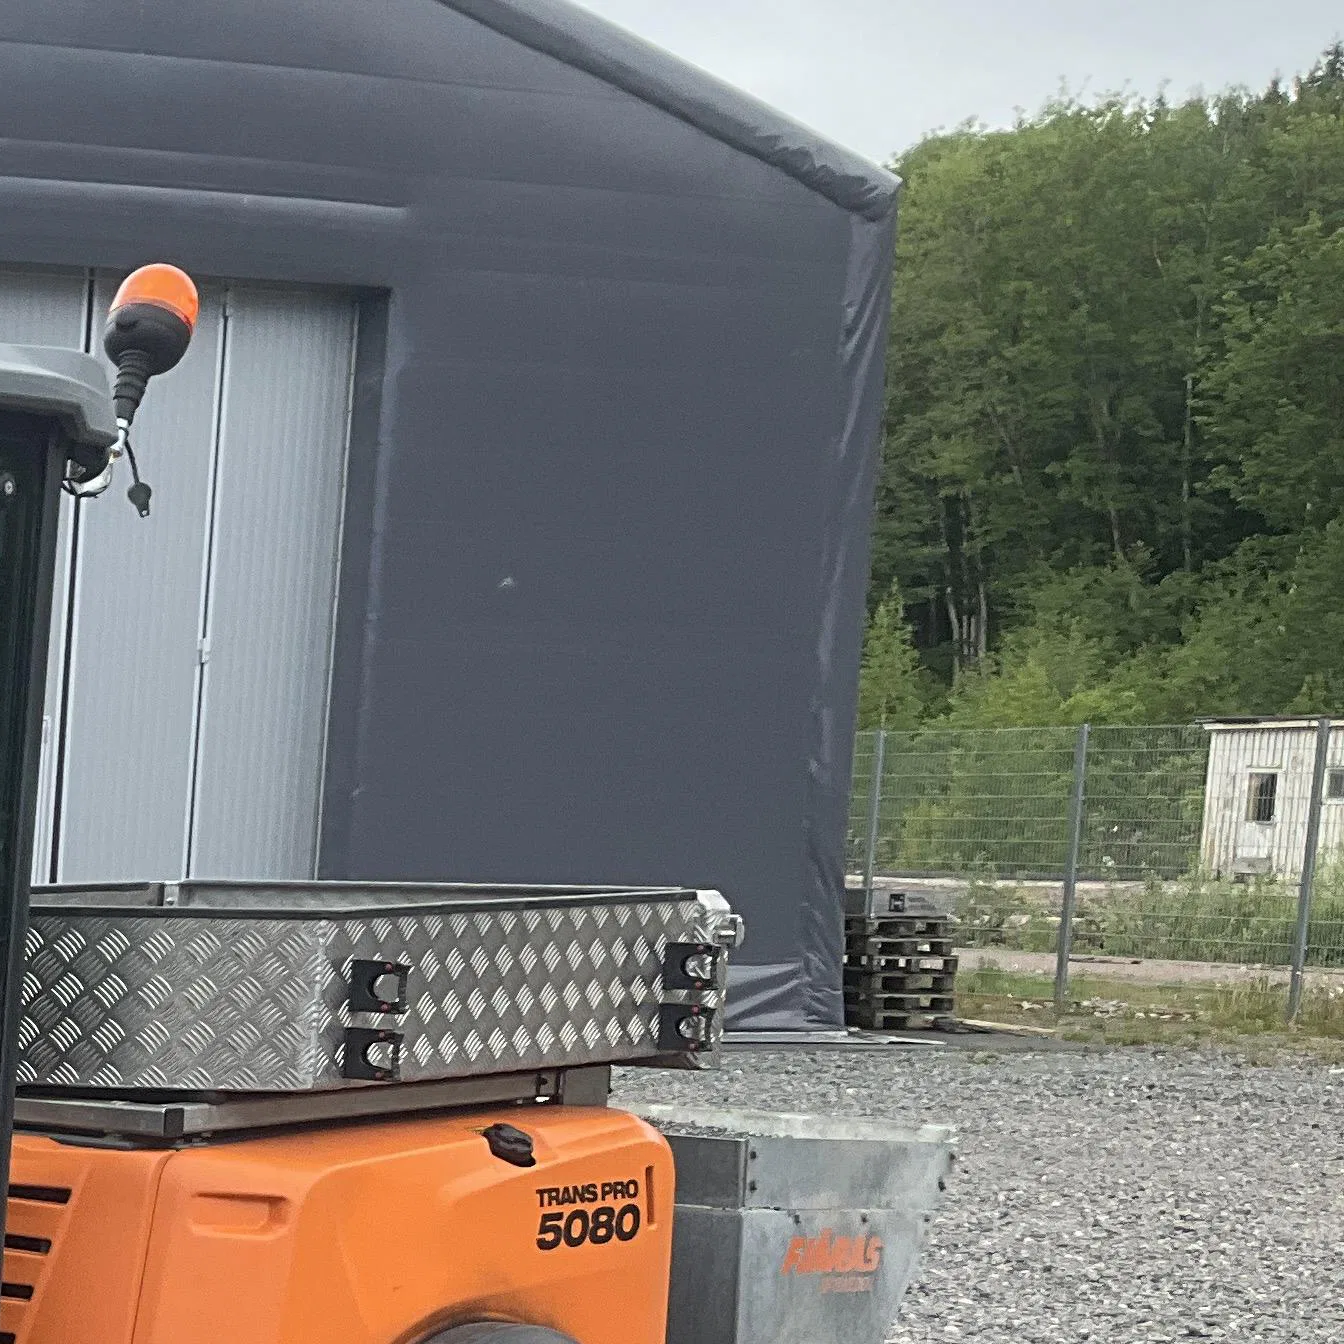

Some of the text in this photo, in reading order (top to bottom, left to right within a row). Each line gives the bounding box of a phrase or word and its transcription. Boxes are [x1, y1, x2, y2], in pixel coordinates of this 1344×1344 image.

[536, 1179, 638, 1207] TRANS PRO
[536, 1203, 640, 1250] 5080
